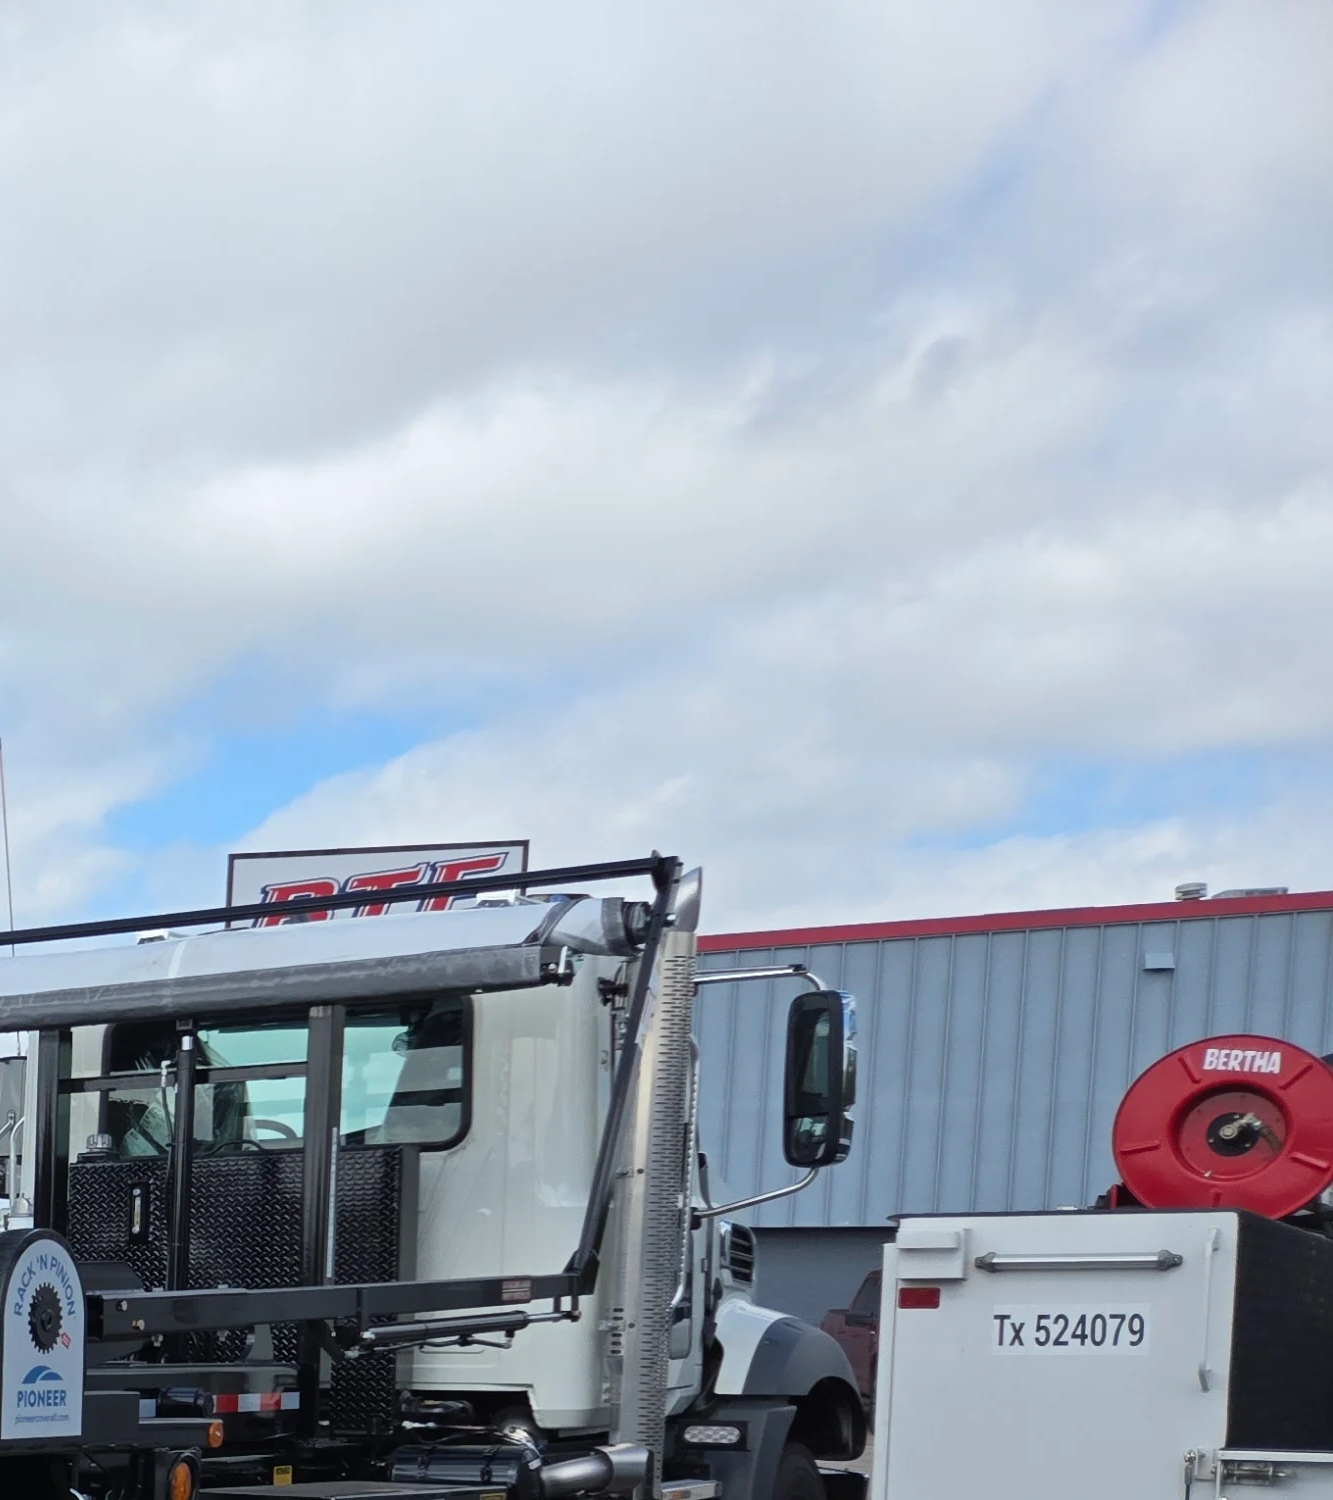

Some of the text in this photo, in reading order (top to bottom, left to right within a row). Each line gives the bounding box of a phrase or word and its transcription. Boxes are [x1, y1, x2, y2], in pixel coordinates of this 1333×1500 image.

[1203, 1048, 1281, 1075] BERTHA
[14, 1261, 36, 1316] RACK
[50, 1256, 76, 1316] PINION
[993, 1313, 1145, 1347] Tx 524079
[16, 1390, 67, 1408] PIONEER
